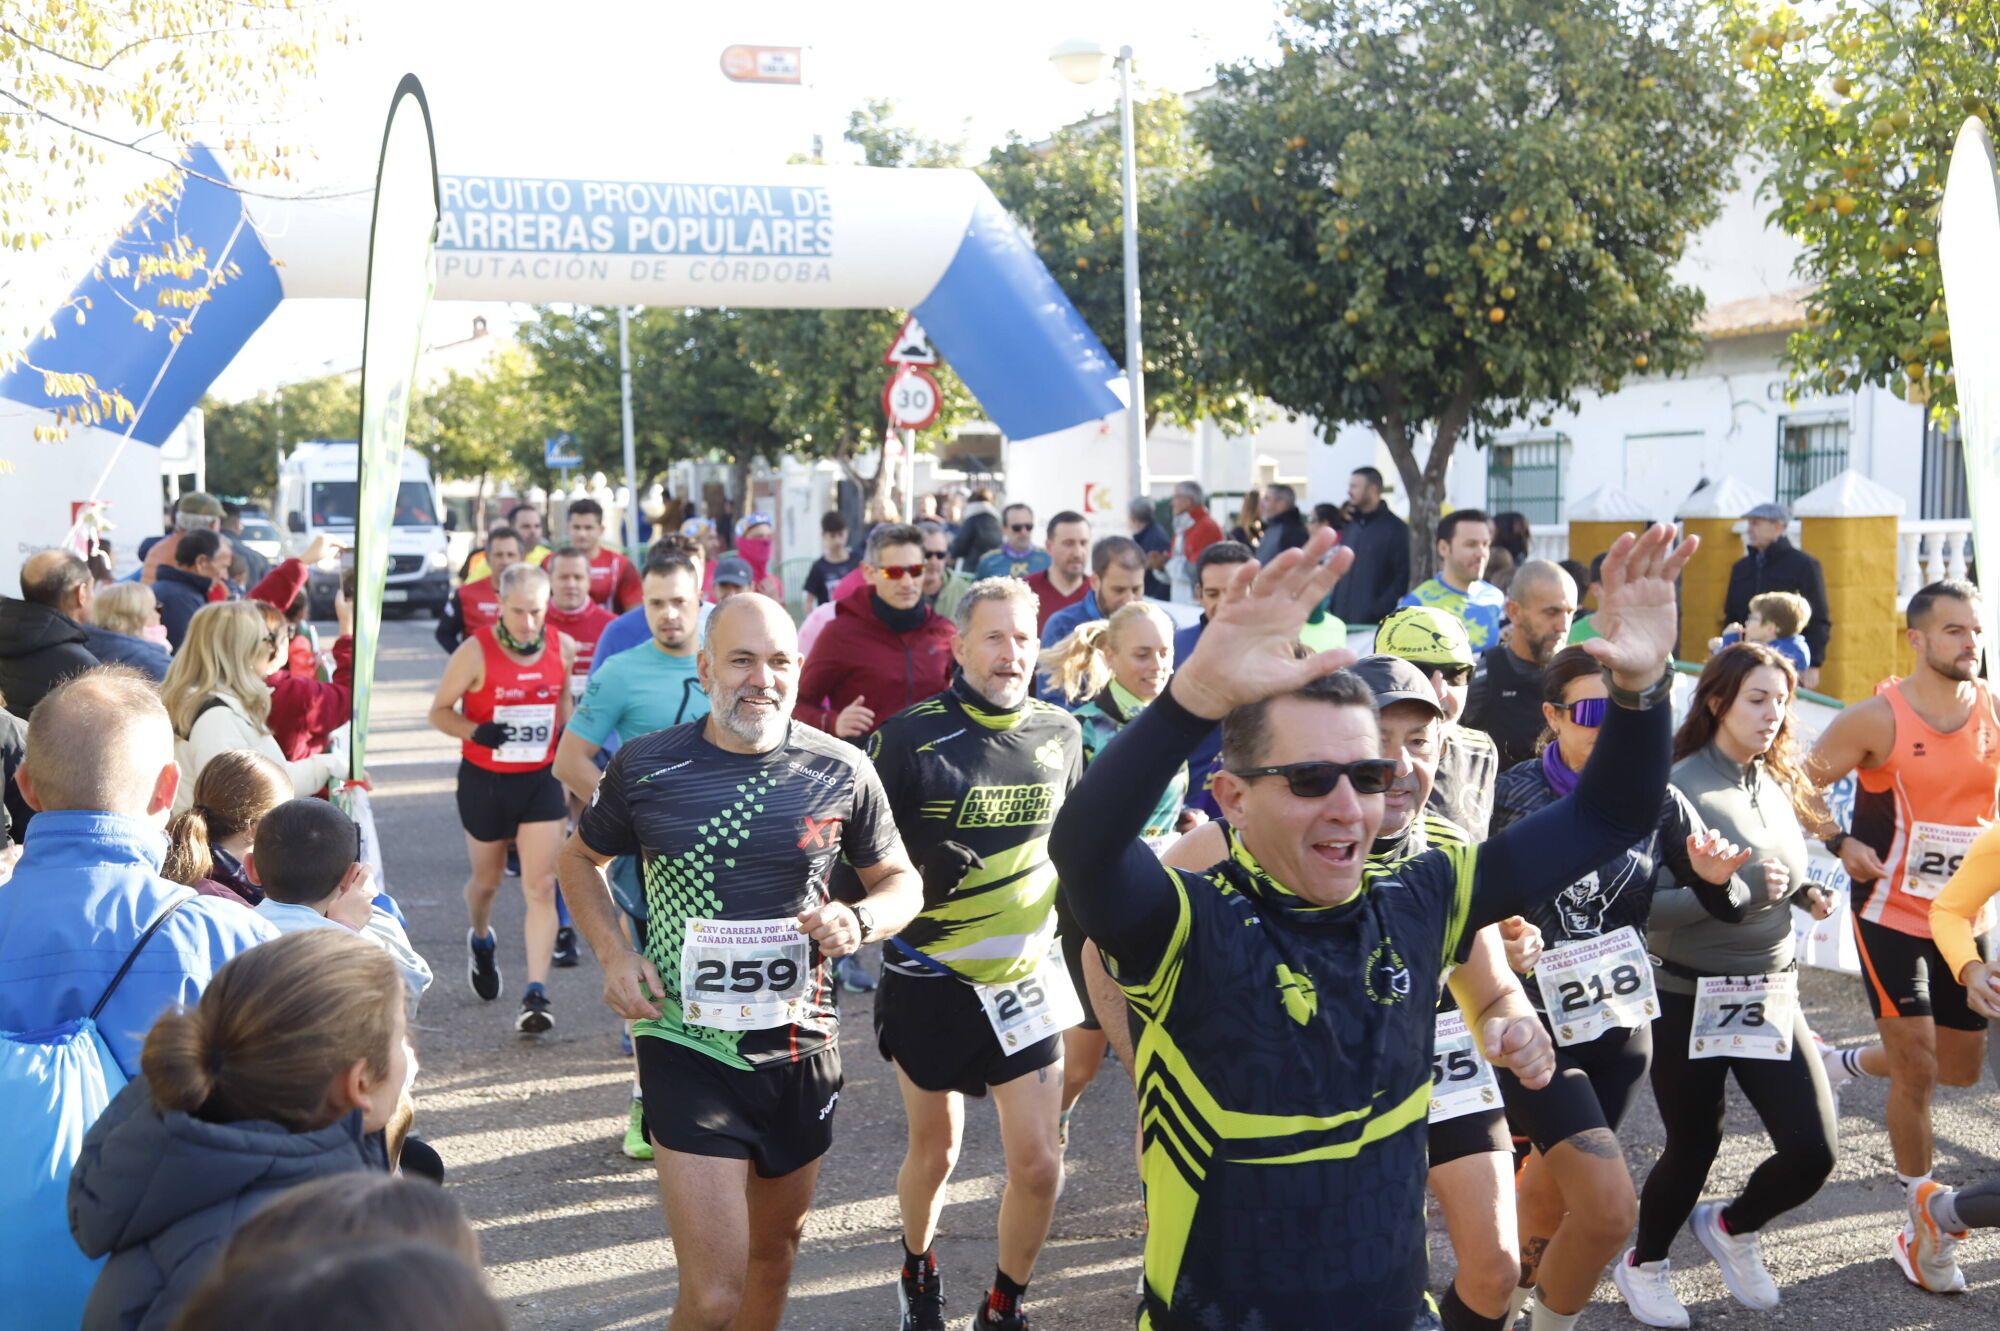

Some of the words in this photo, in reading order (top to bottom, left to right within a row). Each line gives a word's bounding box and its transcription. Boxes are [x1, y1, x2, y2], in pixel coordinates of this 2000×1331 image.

[439, 177, 572, 213] RCUITO
[582, 182, 784, 217] PROVINCIAL
[790, 187, 833, 218] DE
[435, 211, 616, 252] ARRERAS
[628, 214, 833, 254] POPULARES
[437, 253, 608, 281] PUTACIÓN
[630, 260, 668, 281] DE
[688, 256, 832, 283] CÓRDOBA
[898, 389, 928, 411] 30
[503, 726, 549, 742] 239
[800, 765, 836, 786] IMDECO
[969, 785, 1056, 801] AMIGOS
[964, 800, 995, 812] DEL
[998, 798, 1053, 812] COCHE
[959, 810, 1050, 825] ESCOBA
[697, 935, 734, 944] CAÑADA
[736, 935, 759, 944] REAL
[761, 933, 798, 943] SORIANA
[720, 926, 762, 935] CARRERA
[764, 924, 797, 934] POPULA
[695, 959, 798, 993] 259
[994, 978, 1047, 1021] 25
[1559, 965, 1641, 1012] 218
[1717, 1002, 1765, 1027] 73
[1432, 1048, 1478, 1086] 55
